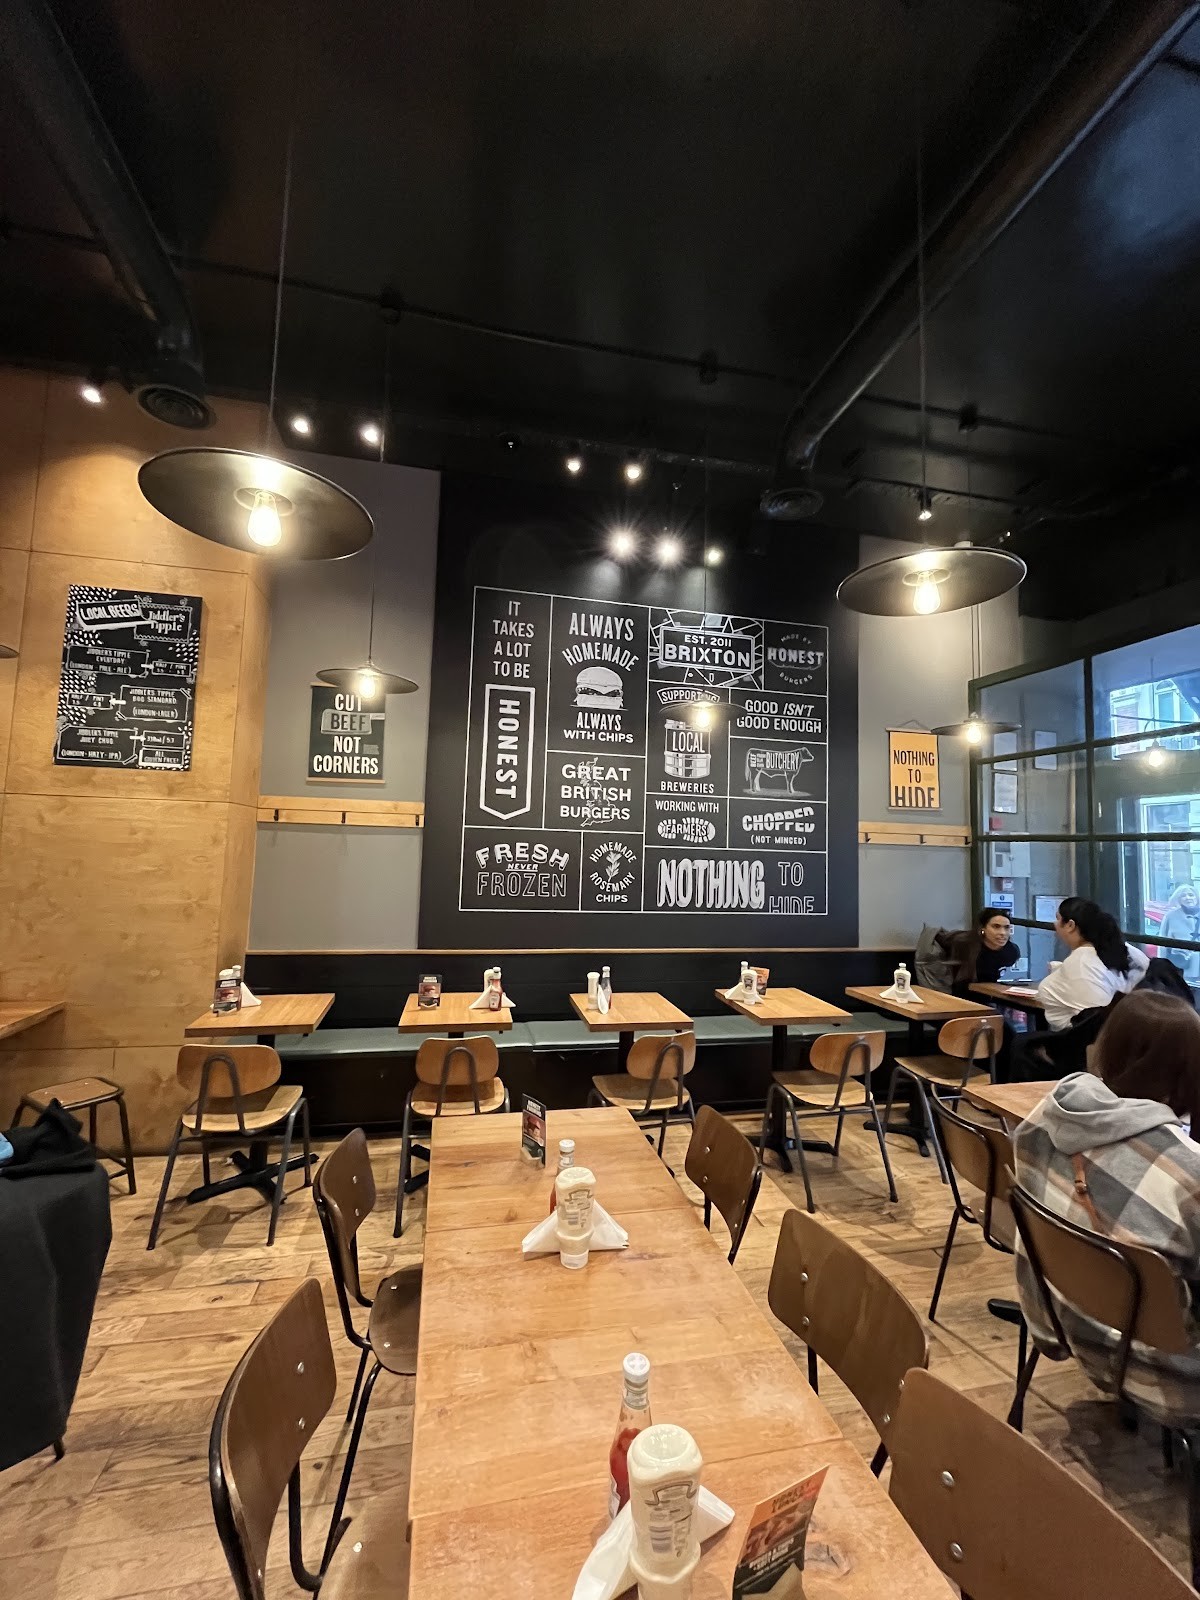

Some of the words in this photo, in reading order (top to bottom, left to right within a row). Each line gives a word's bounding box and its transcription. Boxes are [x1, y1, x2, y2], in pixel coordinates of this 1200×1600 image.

[80, 606, 111, 621] LOCAL
[107, 603, 140, 618] BEERS
[508, 600, 521, 617] IT
[492, 619, 535, 638] TAKES
[569, 612, 634, 641] ALWAYS
[684, 634, 708, 645] EST.
[710, 637, 732, 648] 2011
[780, 633, 799, 642] MADE
[802, 636, 812, 645] BY
[494, 640, 503, 656] A
[506, 641, 532, 658] LOT
[561, 642, 640, 671] HOMEMADE
[664, 643, 750, 668] BRIXTON
[767, 646, 825, 665] HONEST
[493, 660, 510, 677] TO
[513, 662, 531, 679] BE
[779, 671, 813, 686] BURGERS
[147, 696, 177, 704] STANDARD
[334, 693, 363, 712] CUT
[661, 689, 717, 703] SUPPORTNG
[745, 699, 779, 714] GOOD
[783, 702, 815, 717] ISN'T
[330, 713, 366, 731] BEEF
[576, 711, 622, 732] ALWAYS
[736, 716, 770, 730] GOOD
[774, 718, 822, 734] ENOUGH
[333, 735, 362, 754] NOT
[563, 729, 596, 741] WITH
[597, 732, 634, 744] CHIPS
[672, 731, 706, 753] LOCAL
[495, 699, 521, 799] HONEST
[893, 749, 935, 766] NOTHING
[313, 754, 379, 775] CORNERS
[766, 751, 799, 770] BUTCHERY
[561, 763, 632, 782] GREAT
[907, 768, 922, 784] TO
[560, 784, 632, 802] BRITISH
[660, 781, 715, 794] BREWERIES
[894, 785, 936, 807] HIDE
[559, 805, 631, 821] BURGERS
[655, 799, 696, 812] WORKING
[697, 801, 720, 813] WITH
[742, 806, 815, 833] CHOPPED
[666, 823, 707, 837] FARMERS
[750, 834, 771, 845] (NOT
[774, 836, 807, 846] MINCED)
[475, 842, 570, 871] FRESH
[589, 841, 637, 863] HOMEMADE
[476, 871, 567, 897] FROZEN
[589, 871, 635, 893] ROSEMARY
[656, 858, 765, 909] NOTHING
[777, 861, 804, 887] TO
[595, 893, 629, 903] CHIPS
[769, 896, 815, 913] HIDE
